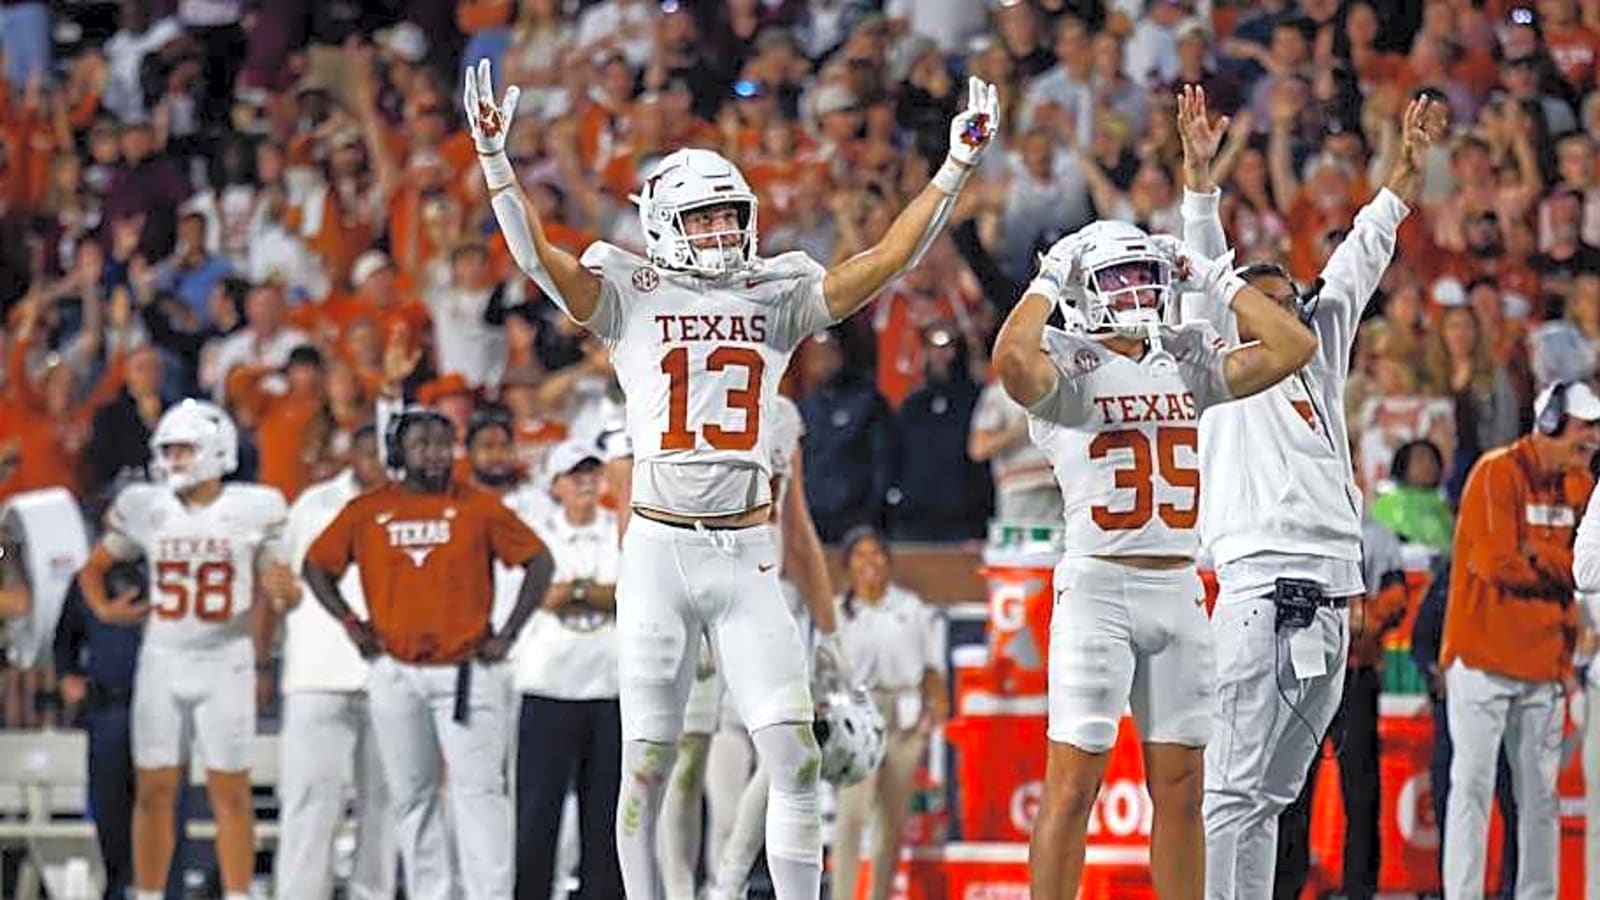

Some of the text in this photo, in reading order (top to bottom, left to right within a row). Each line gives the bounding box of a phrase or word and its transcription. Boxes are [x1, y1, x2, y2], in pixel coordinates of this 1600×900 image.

[655, 315, 767, 342] TEXAS
[660, 346, 765, 450] 13
[1094, 392, 1197, 424] TEXAS
[1089, 427, 1200, 531] 35
[158, 538, 232, 558] TEXAS
[387, 520, 450, 547] TEXAS
[156, 561, 234, 621] 58
[991, 586, 1025, 630] G
